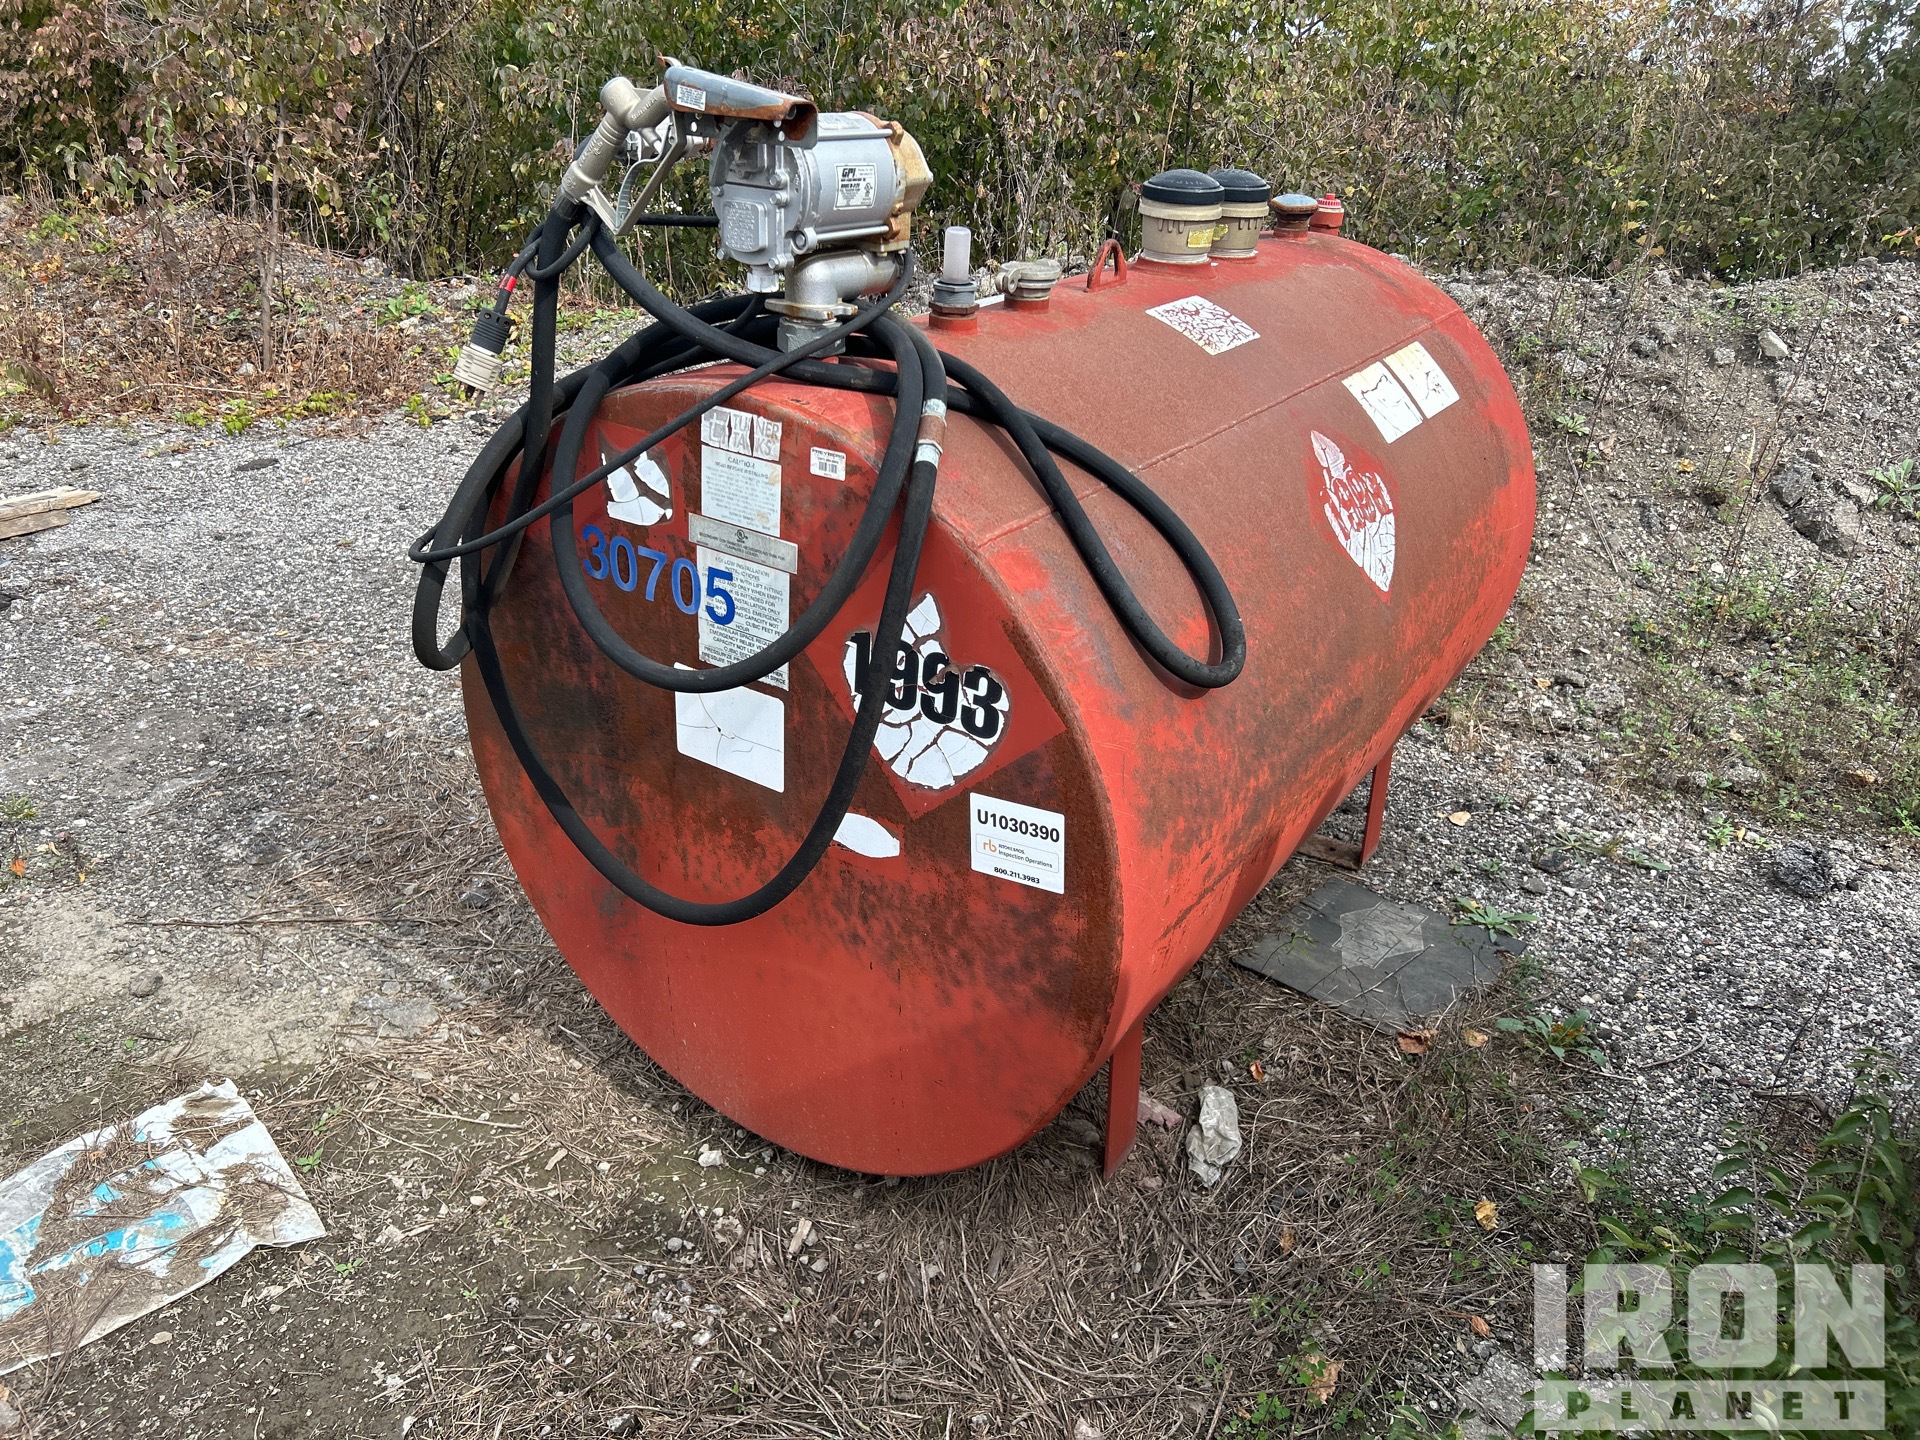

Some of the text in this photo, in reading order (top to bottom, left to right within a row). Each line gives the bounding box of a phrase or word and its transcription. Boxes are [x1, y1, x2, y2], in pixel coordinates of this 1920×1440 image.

[842, 168, 856, 178] GPI
[582, 524, 736, 627] 30705
[738, 584, 749, 592] ONLY
[767, 607, 780, 616] ONLY
[744, 614, 767, 625] CAPACITY
[735, 624, 749, 632] HOUR
[739, 632, 753, 641] SPACE
[770, 675, 785, 685] SPACE
[851, 631, 1003, 739] 1993
[977, 808, 1060, 843] U1030390
[998, 849, 1053, 869] Inspection Operations
[993, 866, 1040, 884] 800.211.3983
